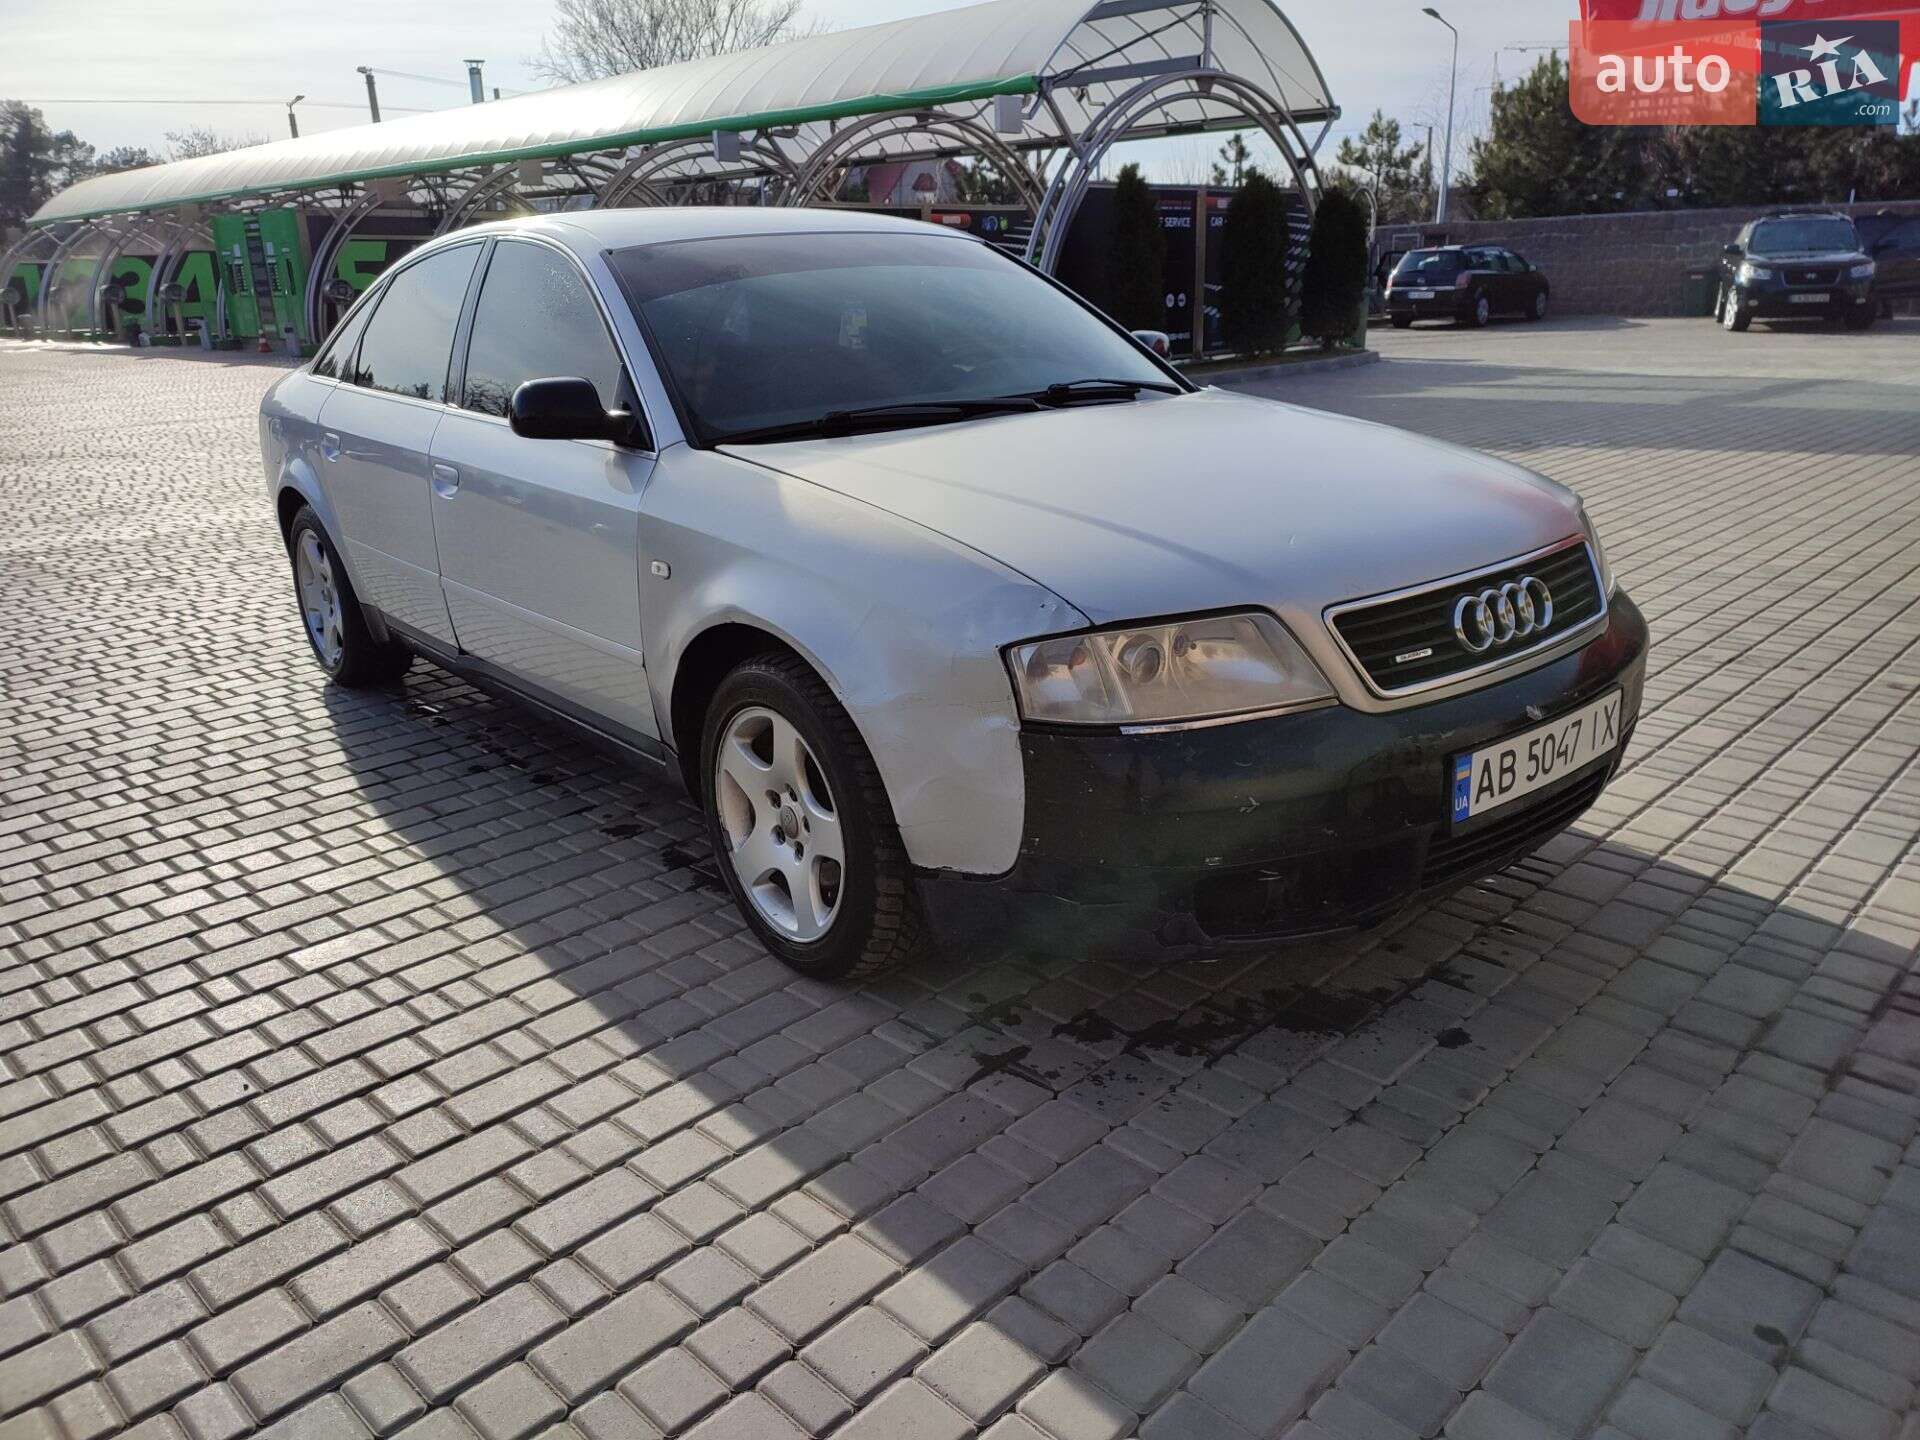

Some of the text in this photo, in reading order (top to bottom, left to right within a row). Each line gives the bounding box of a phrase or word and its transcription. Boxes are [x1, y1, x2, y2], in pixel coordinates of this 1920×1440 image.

[1475, 700, 1618, 804] AB 5047 IX
[1454, 794, 1469, 812] UA
